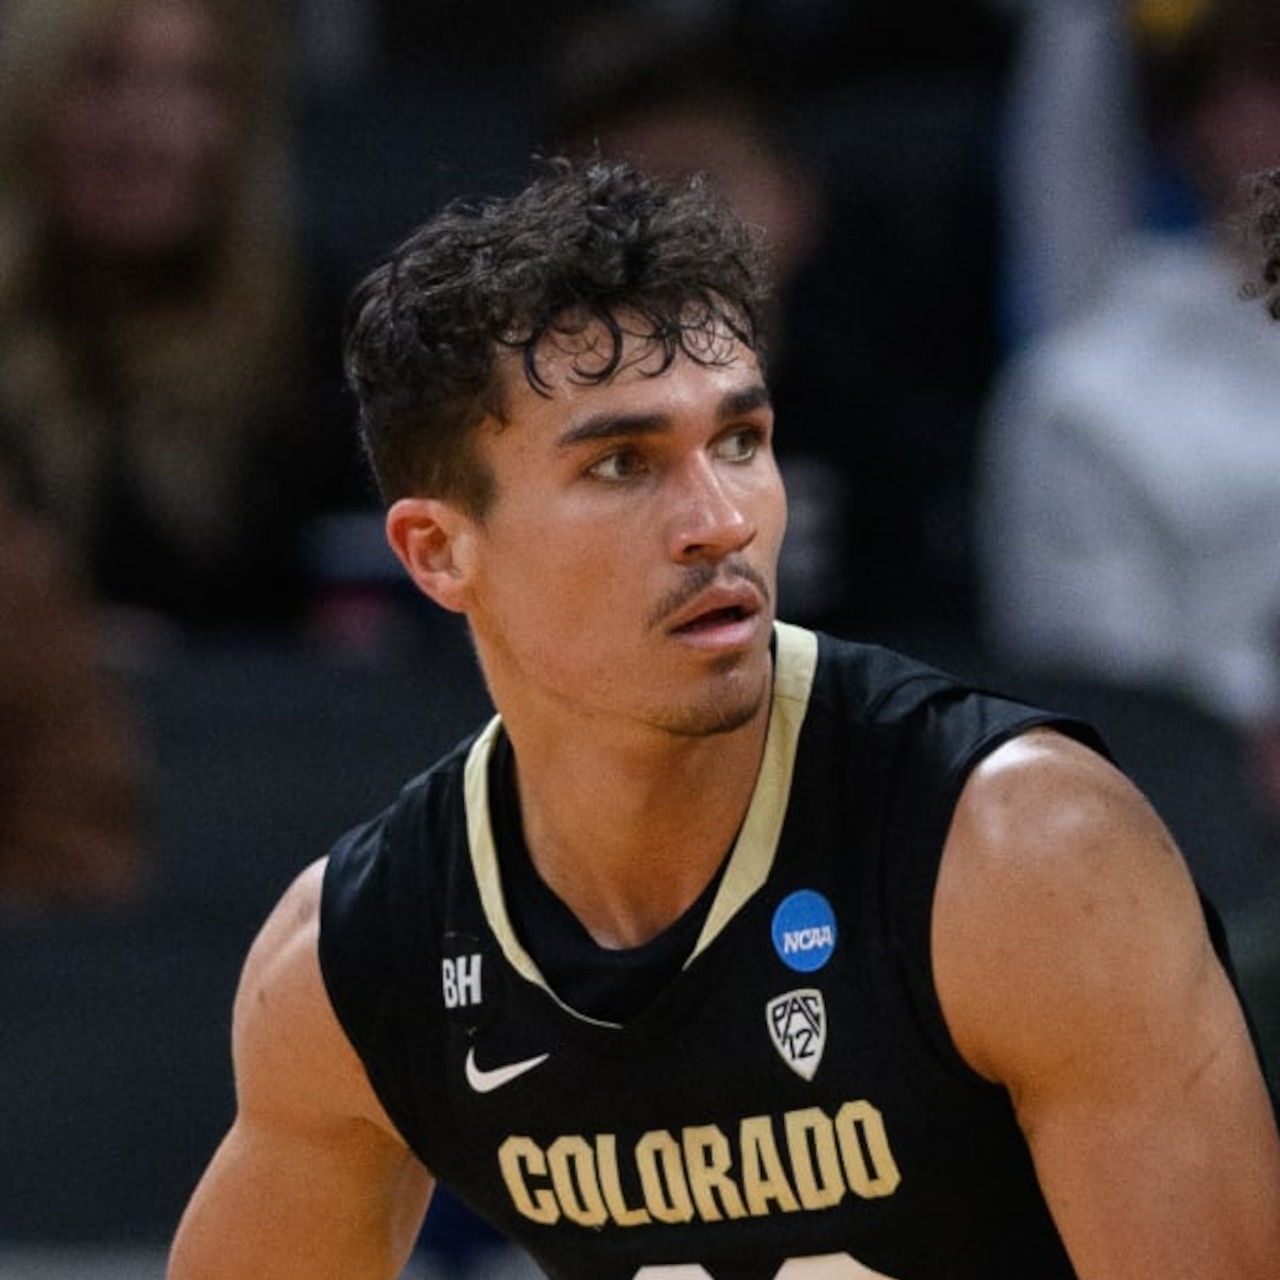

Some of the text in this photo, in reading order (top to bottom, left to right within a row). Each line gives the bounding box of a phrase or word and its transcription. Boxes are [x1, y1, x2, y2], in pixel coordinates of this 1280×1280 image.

[783, 925, 833, 954] NCAA
[442, 953, 483, 1009] BH
[772, 995, 821, 1046] PAC
[787, 1028, 816, 1060] 12
[498, 1099, 901, 1228] COLORADO
